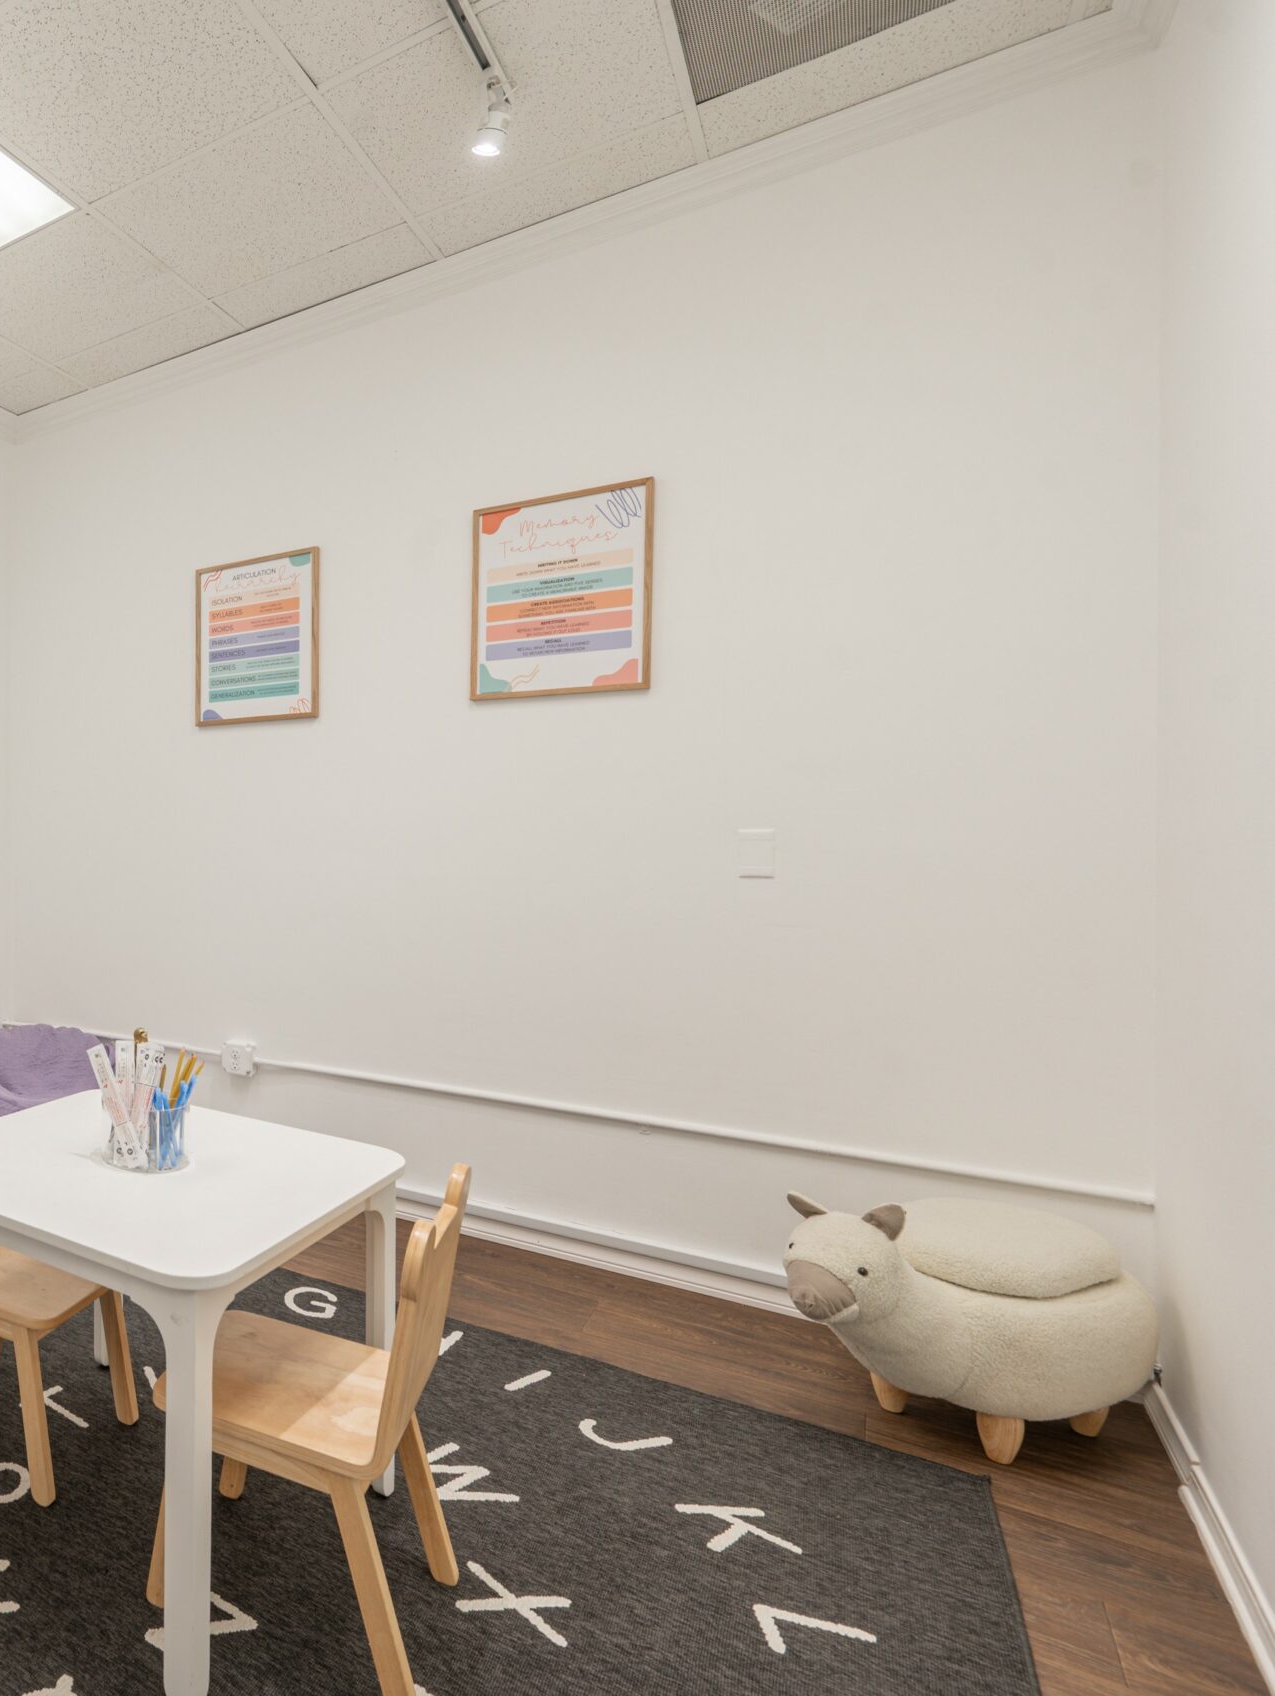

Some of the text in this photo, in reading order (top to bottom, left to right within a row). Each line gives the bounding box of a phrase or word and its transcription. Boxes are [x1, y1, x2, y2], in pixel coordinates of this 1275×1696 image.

[519, 511, 600, 537] Memory
[498, 530, 618, 558] Techniques
[232, 568, 276, 582] ARTICULATION
[539, 577, 575, 585] VISUALIZATION
[211, 595, 242, 606] ISOLATION
[211, 609, 243, 620] SYLLABLES
[211, 624, 234, 634] WORDS
[211, 637, 238, 647] PHRASES
[211, 649, 245, 660] SENTENCES
[211, 664, 236, 673] STORIES
[211, 675, 256, 687] CONVERSATIONS
[211, 689, 255, 700] GENERALIZATION
[284, 1286, 338, 1319] G
[579, 1418, 674, 1451] J
[674, 1503, 803, 1555] K
[456, 1560, 573, 1647] X
[752, 1603, 878, 1655] L
